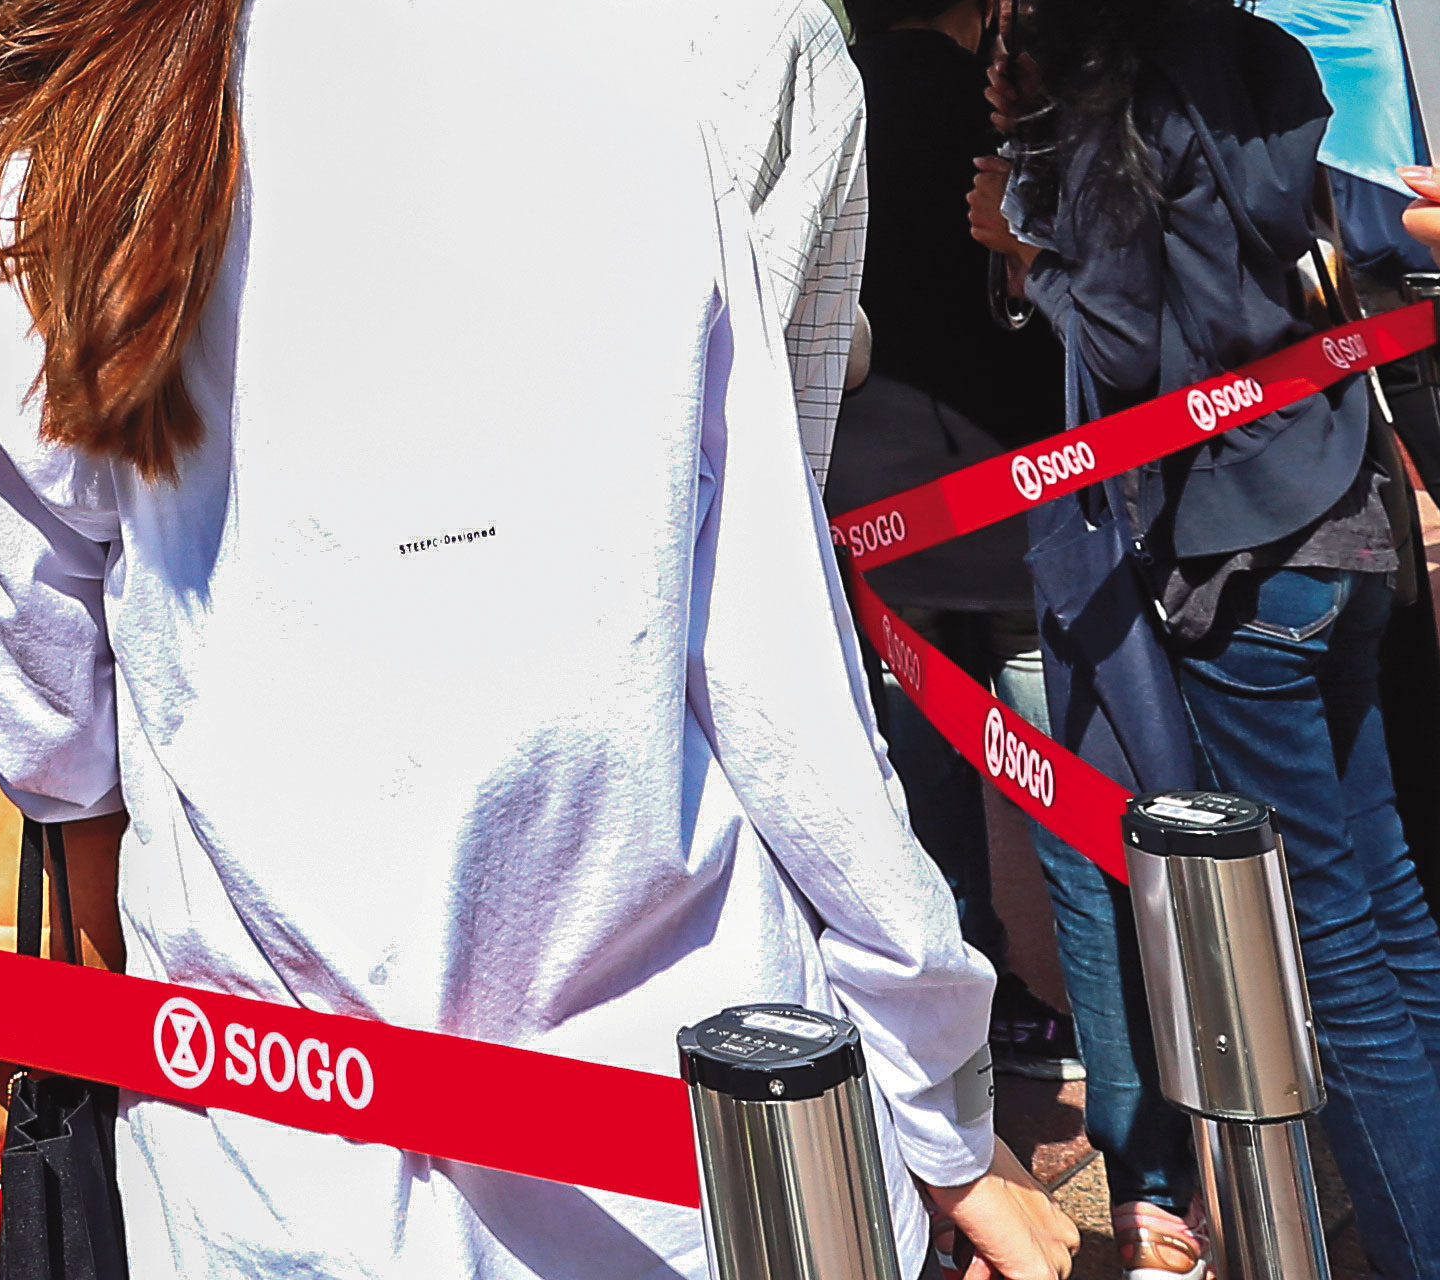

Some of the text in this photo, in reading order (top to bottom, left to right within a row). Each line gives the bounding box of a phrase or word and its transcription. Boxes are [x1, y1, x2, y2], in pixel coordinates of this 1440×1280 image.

[1211, 376, 1264, 421] SOGO
[1037, 440, 1096, 486] SOGO
[848, 510, 906, 558] SOGO
[1004, 730, 1055, 808] SOGO
[223, 1022, 376, 1110] SOGO
